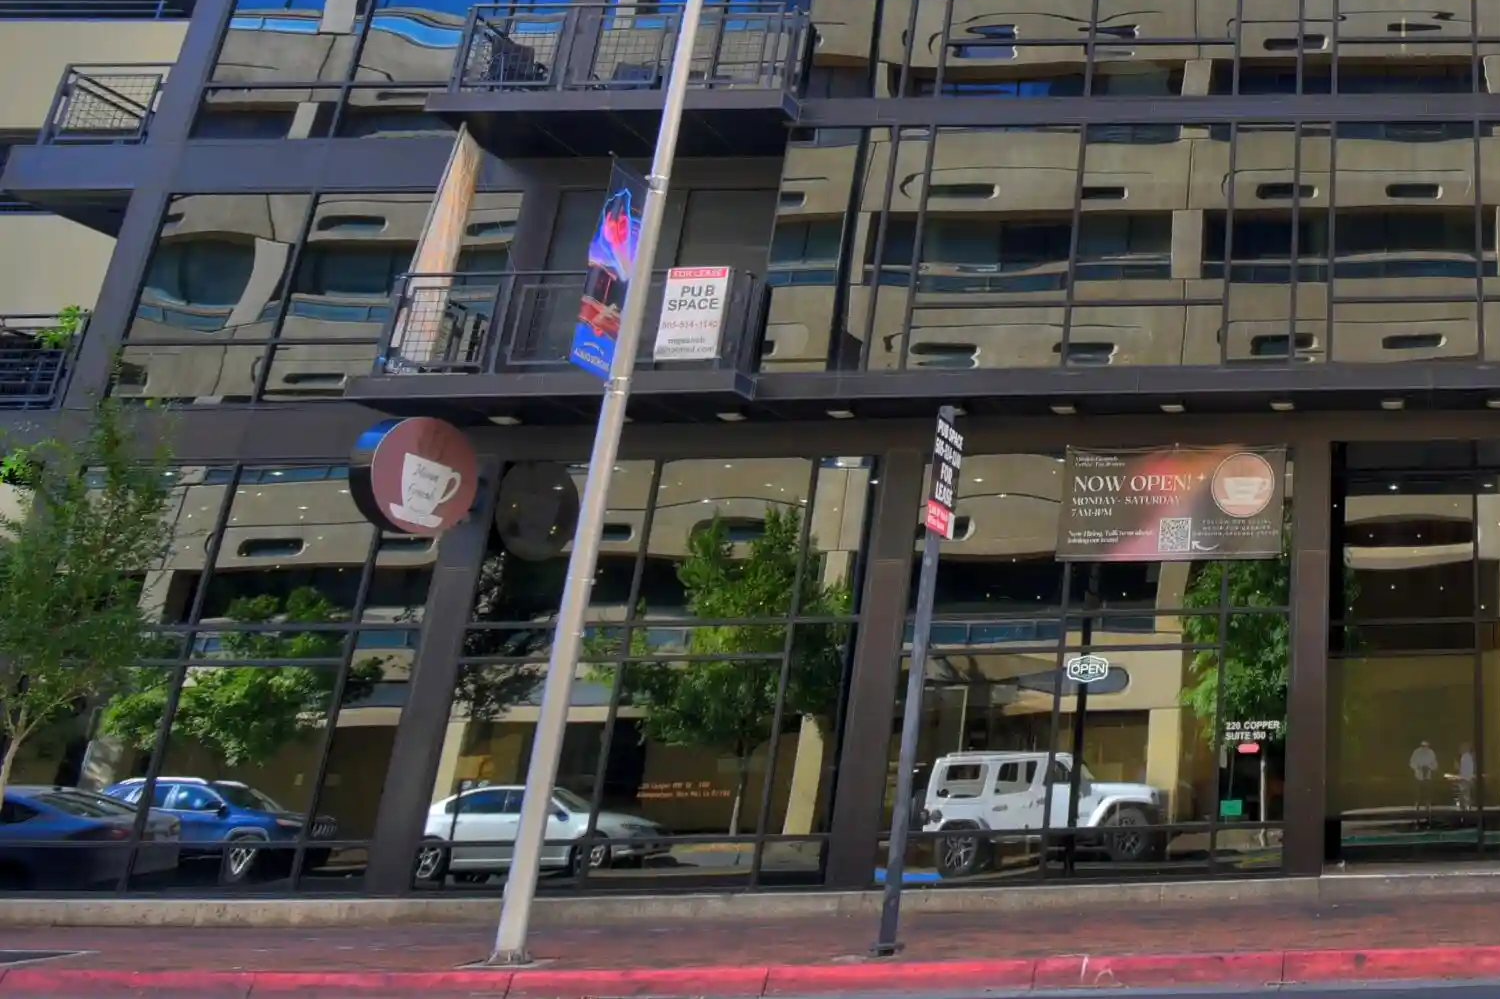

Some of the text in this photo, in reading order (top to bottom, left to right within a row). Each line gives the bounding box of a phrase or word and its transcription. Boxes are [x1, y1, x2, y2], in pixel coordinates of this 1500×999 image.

[680, 284, 716, 298] PUB
[667, 298, 720, 312] SPACE
[940, 461, 953, 485] FOR
[1073, 472, 1192, 492] NOW OPEN!
[934, 480, 953, 508] LEASE
[1124, 494, 1181, 506] SATURDAY
[1071, 662, 1105, 675] OPEN
[1225, 720, 1281, 731] 220 COPPER
[1225, 731, 1252, 741] SUITE
